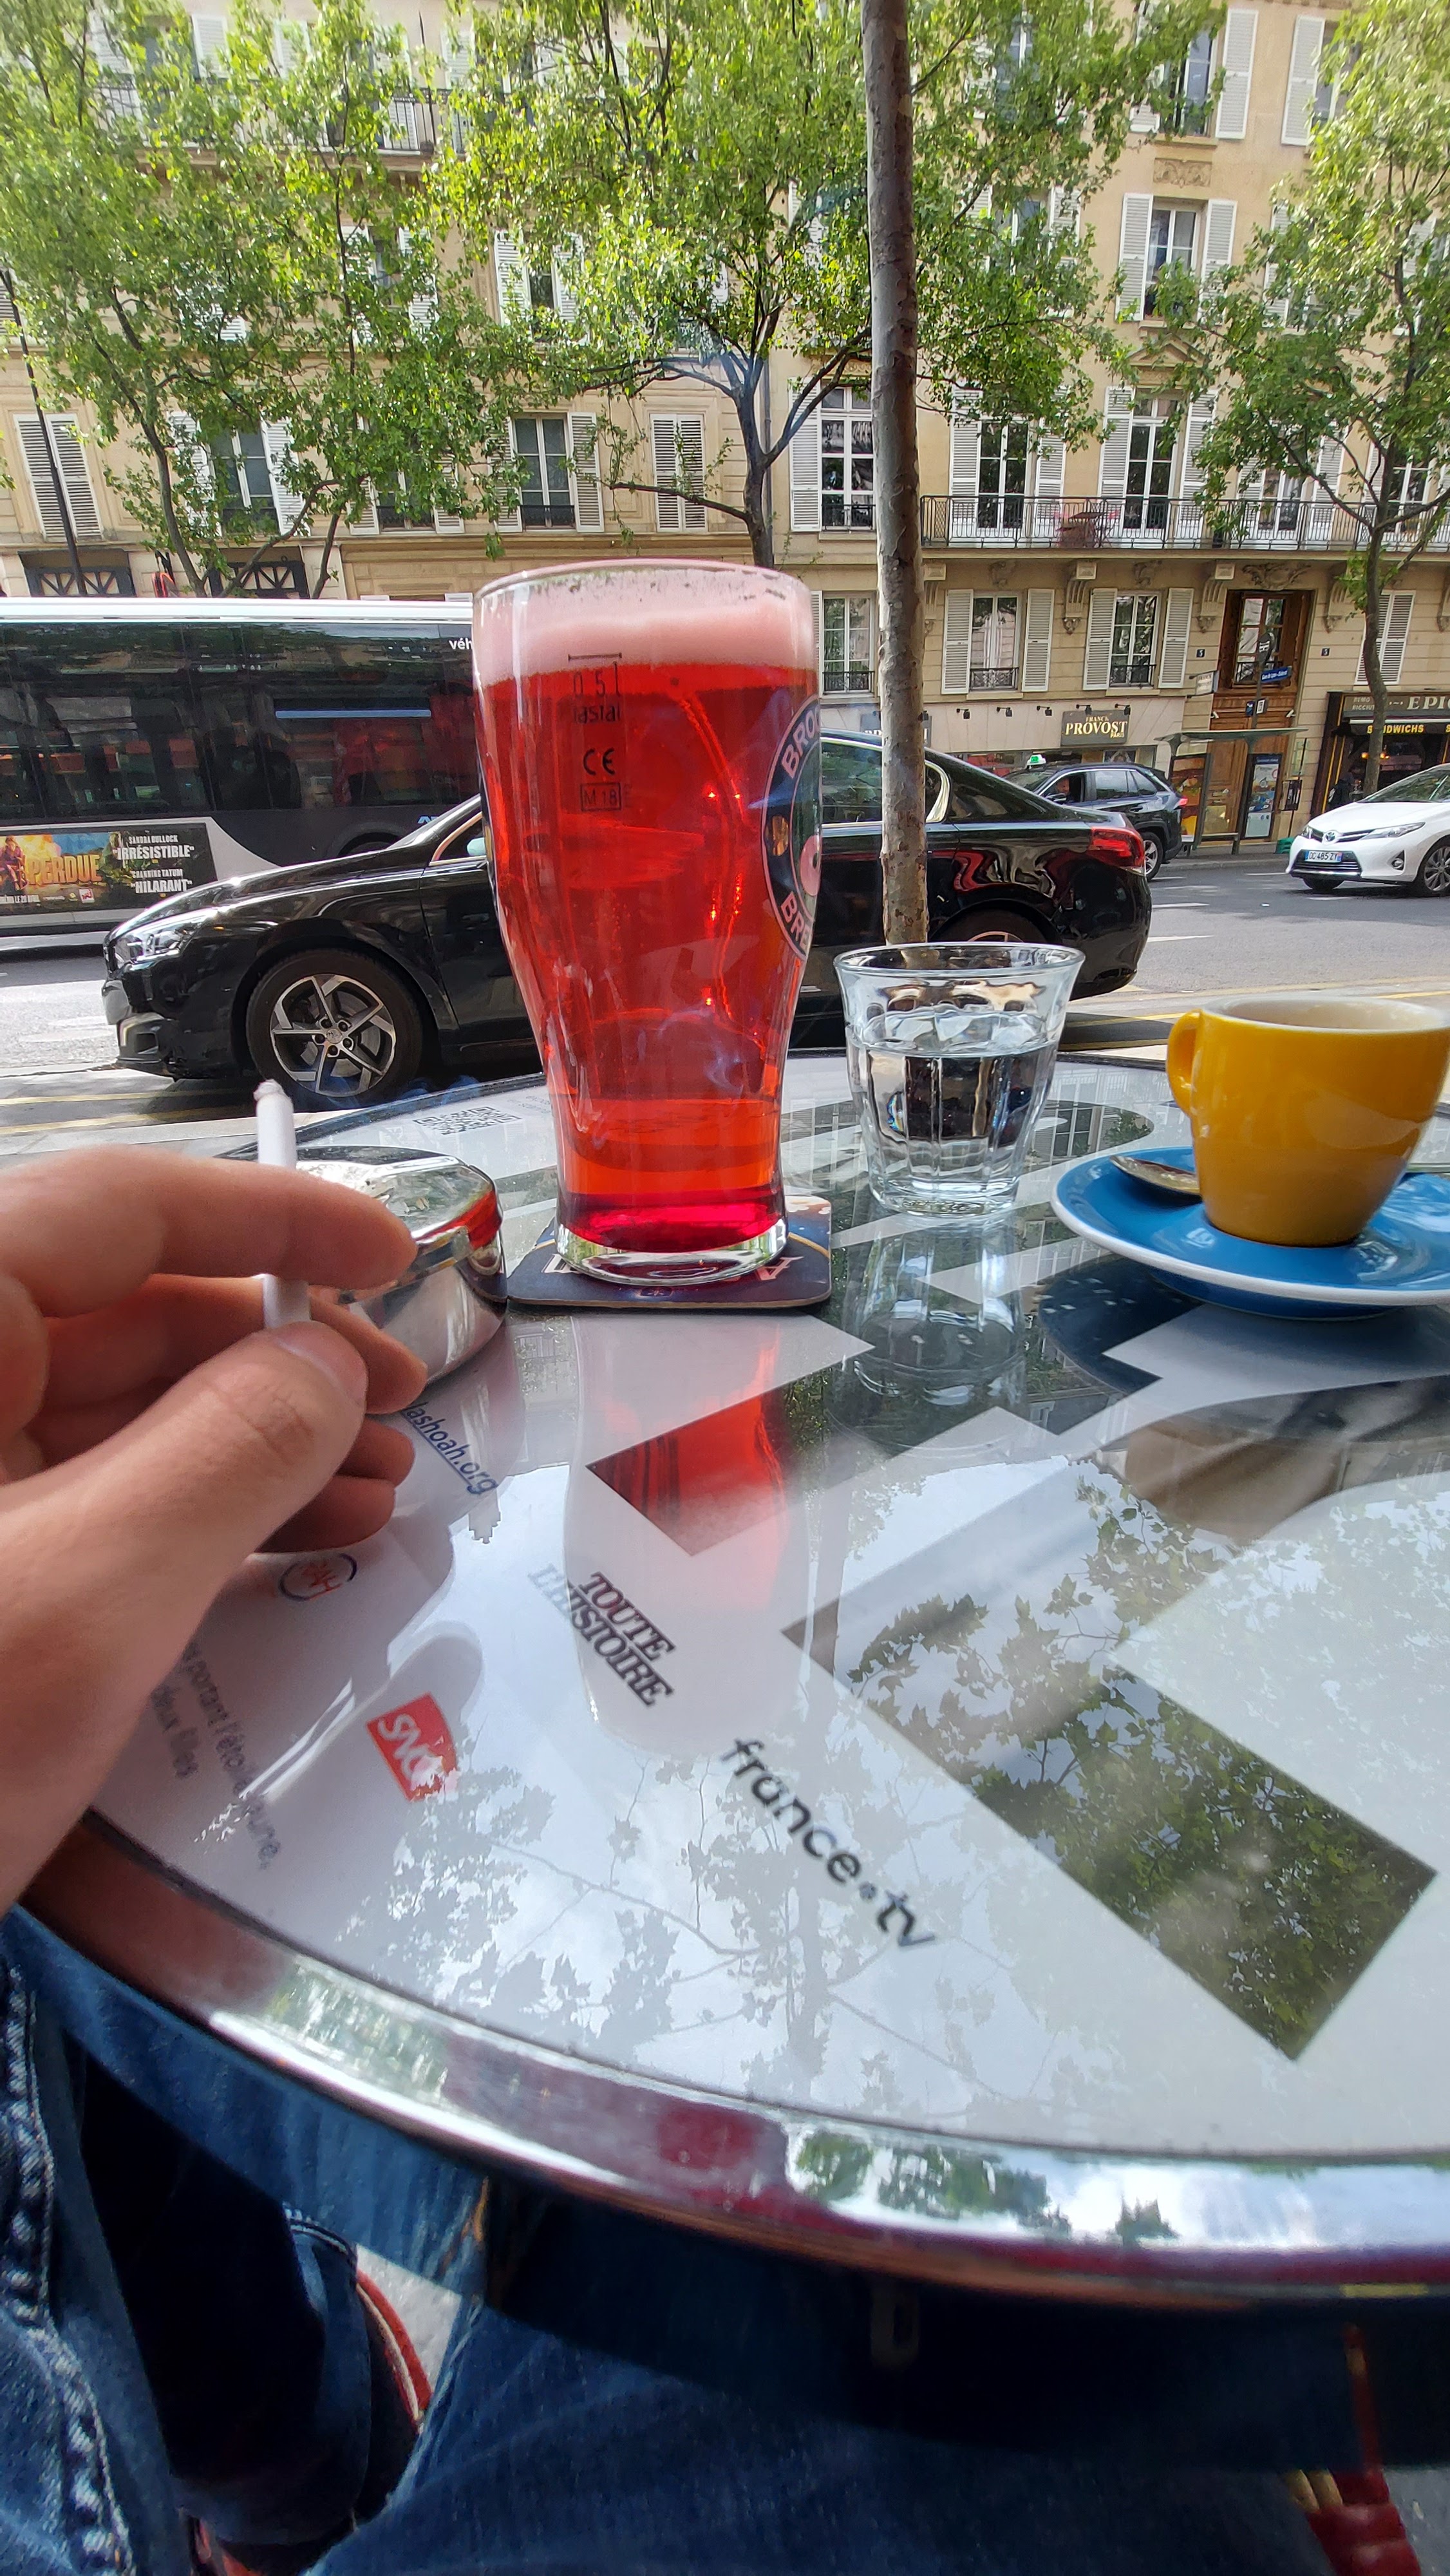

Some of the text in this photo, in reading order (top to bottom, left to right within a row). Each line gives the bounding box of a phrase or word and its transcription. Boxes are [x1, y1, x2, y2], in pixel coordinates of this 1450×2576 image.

[1407, 696, 1450, 710] EPI
[1066, 721, 1127, 735] PROVOST
[1367, 724, 1424, 734] SDWICHS
[583, 748, 616, 775] CE
[28, 855, 102, 886] PERDUE
[578, 1571, 676, 1662] TOUTE
